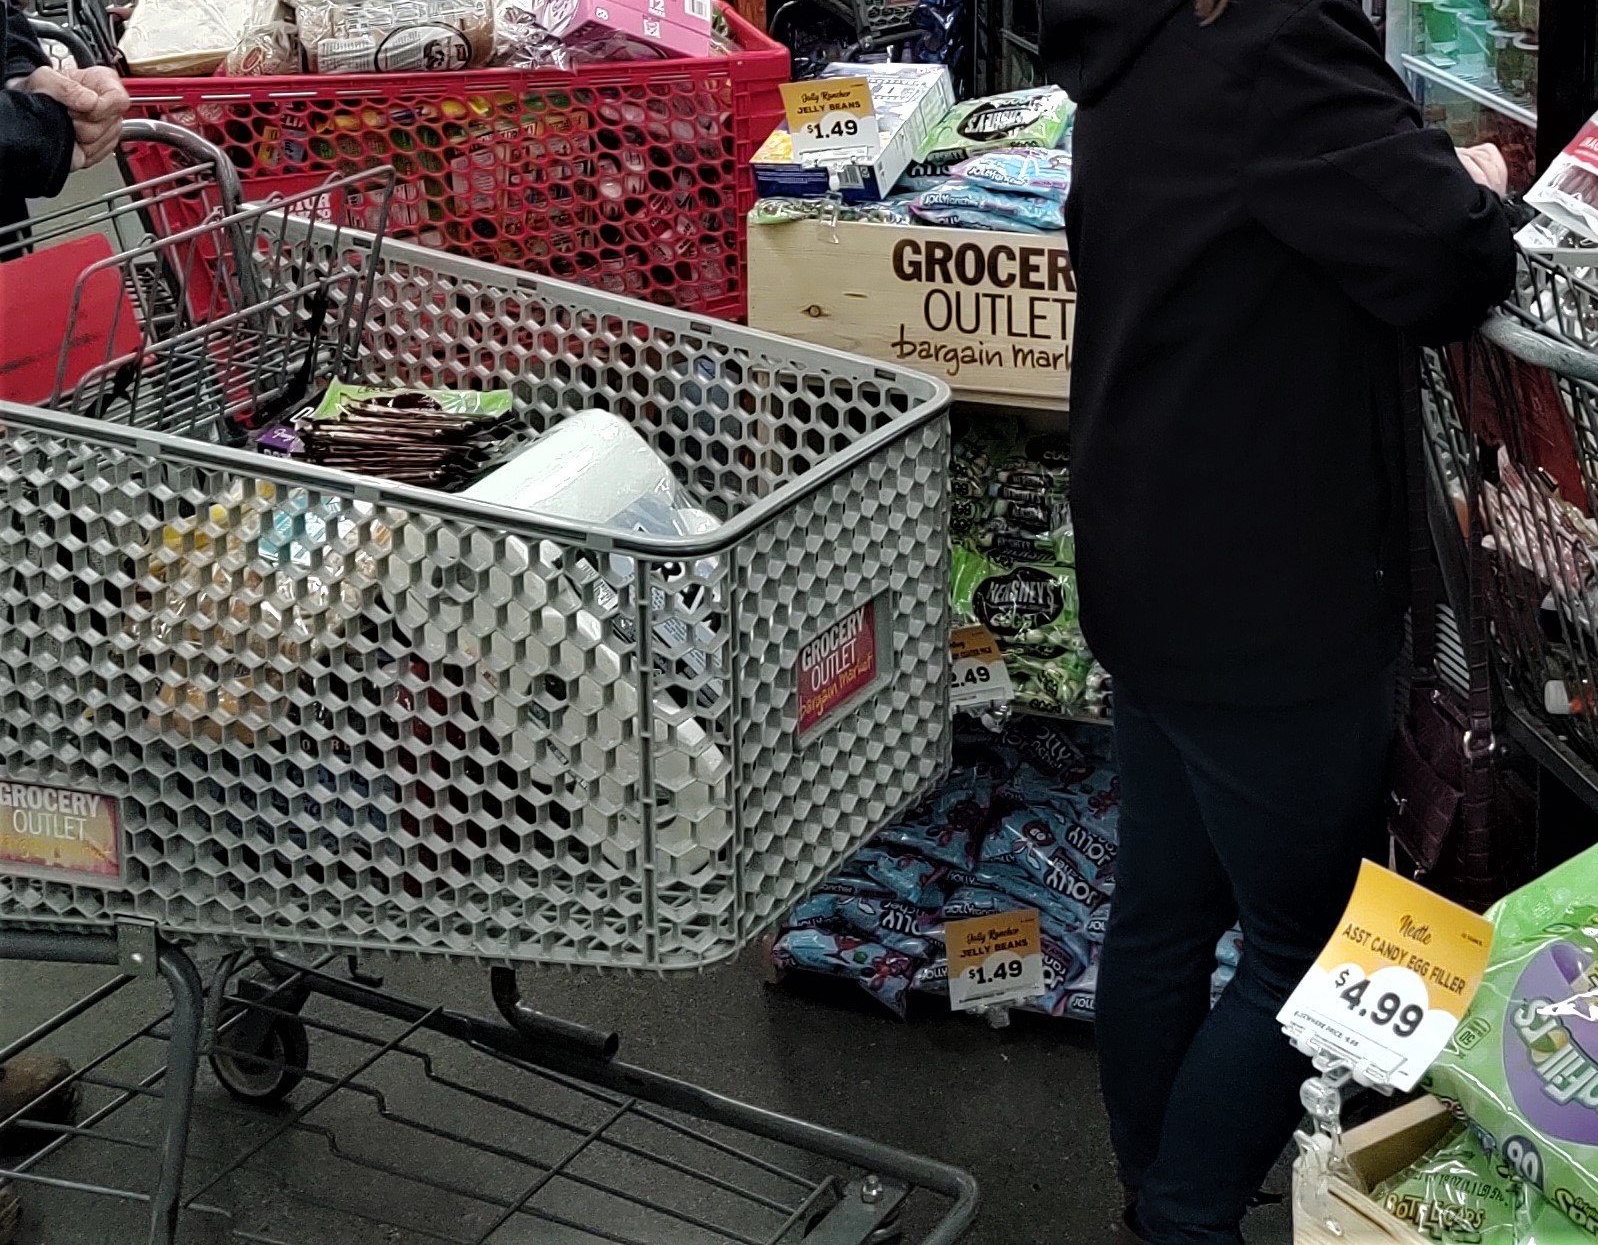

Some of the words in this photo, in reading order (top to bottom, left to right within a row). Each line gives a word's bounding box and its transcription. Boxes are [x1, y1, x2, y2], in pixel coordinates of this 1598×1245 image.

[797, 105, 825, 114] JELLY
[829, 101, 861, 111] BEANS
[807, 119, 858, 139] $1.49
[892, 238, 1076, 293] GROCER
[924, 288, 1076, 341] OUTLET
[891, 324, 1002, 376] bargain
[988, 580, 1056, 606] HERSHEY'S
[802, 606, 864, 672] GROCERY
[811, 639, 856, 691] OUTLET
[0, 782, 100, 817] GROCERY
[13, 809, 87, 841] OUTLET
[1399, 914, 1433, 946] Nestle
[959, 943, 991, 958] JELLY
[994, 939, 1029, 952] BEANS
[1342, 923, 1372, 947] ASST
[1370, 937, 1407, 965] CANDY
[1406, 955, 1430, 977] EGG
[1429, 965, 1467, 995] FILLER
[968, 960, 1022, 985] $1.49
[1334, 968, 1424, 1039] $4.99
